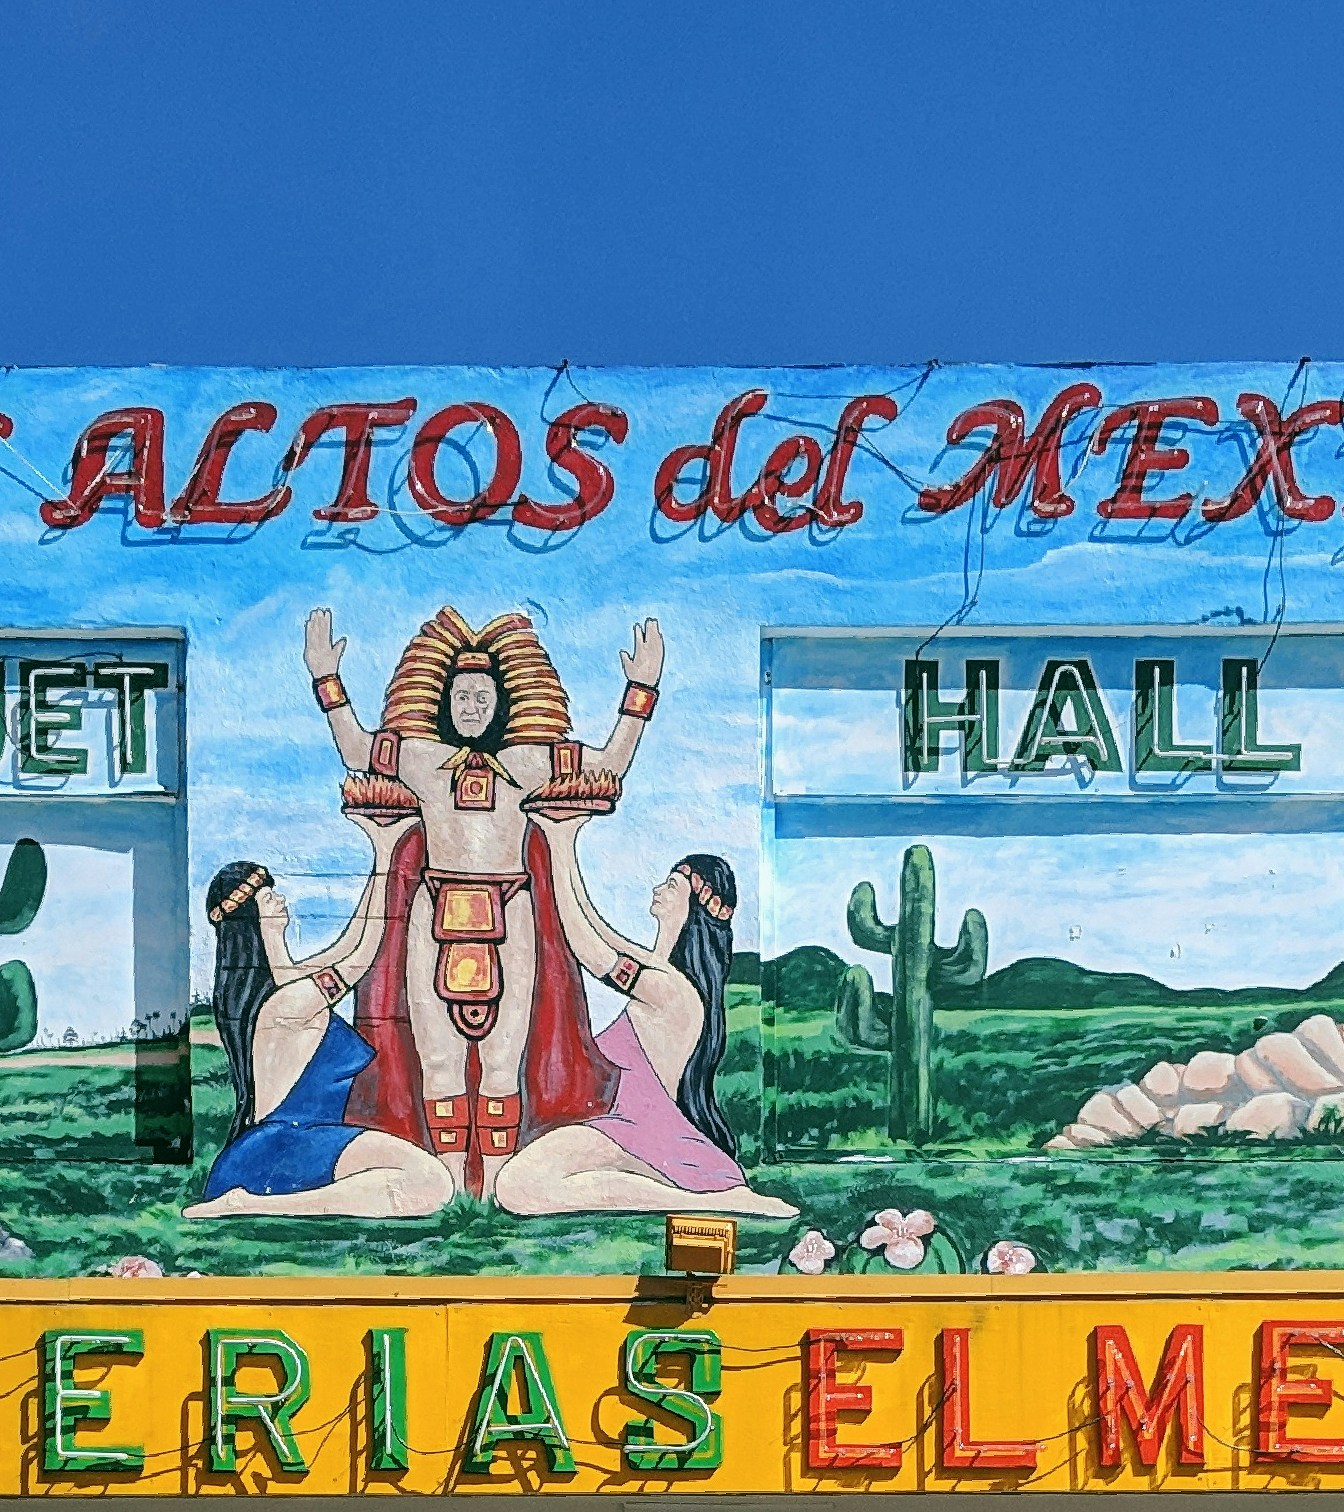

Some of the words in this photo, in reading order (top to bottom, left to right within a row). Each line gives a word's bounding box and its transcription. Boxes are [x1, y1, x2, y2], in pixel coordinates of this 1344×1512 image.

[40, 398, 630, 532] ALTOS
[658, 391, 898, 528] del
[903, 657, 1302, 773] HALL
[805, 1326, 1049, 1470] EL
